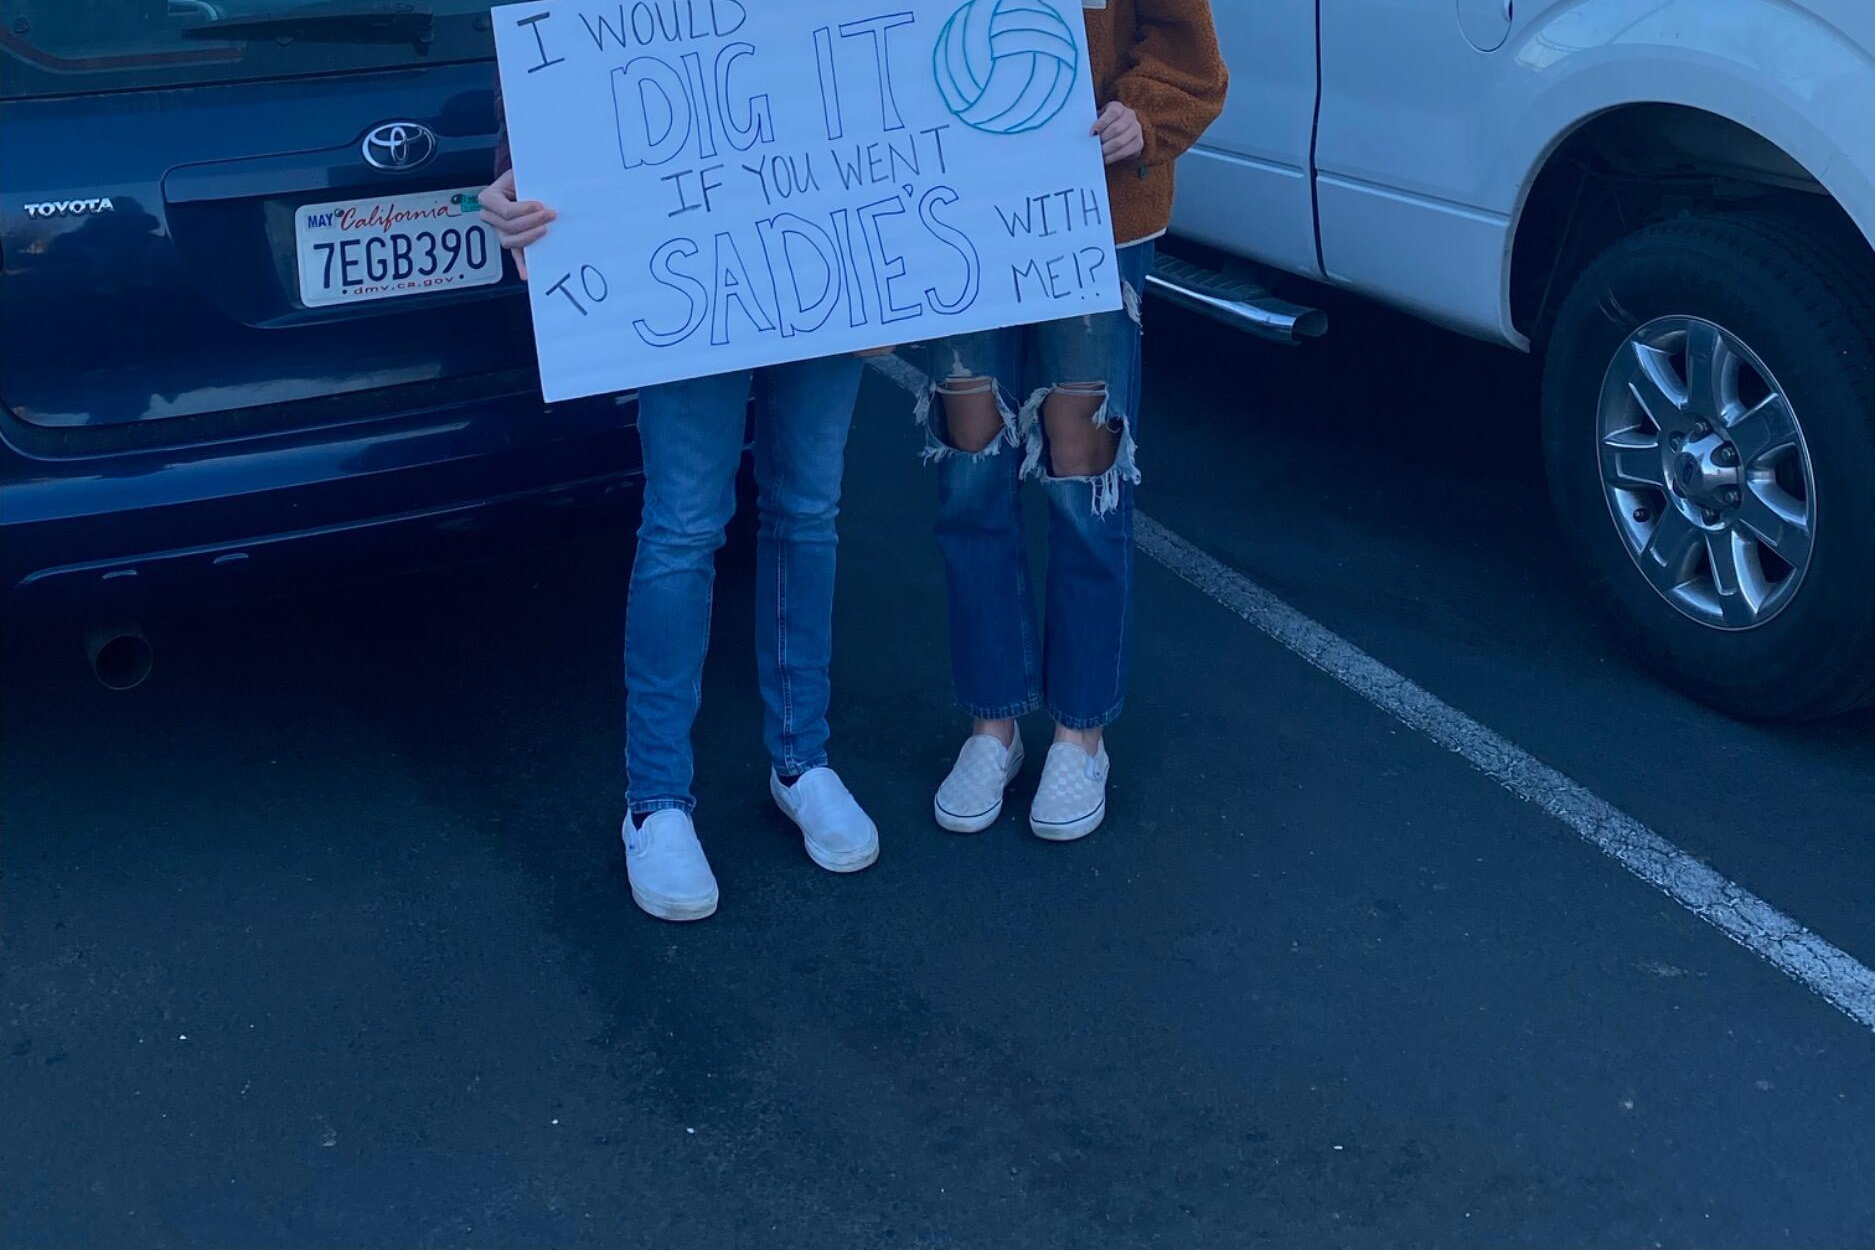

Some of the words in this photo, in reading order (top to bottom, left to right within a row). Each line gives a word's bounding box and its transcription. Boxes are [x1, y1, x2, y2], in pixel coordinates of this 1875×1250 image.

[517, 12, 565, 73] I
[610, 41, 775, 170] DIG
[813, 11, 915, 140] IT
[660, 164, 725, 218] IF
[742, 152, 820, 205] YOU
[831, 125, 950, 190] WENT
[24, 197, 115, 217] TOYOTA
[308, 212, 333, 229] MAY
[340, 203, 462, 233] California
[313, 225, 487, 289] 7EGB390
[353, 276, 455, 295] dmv.ca.gov
[545, 264, 608, 317] TO
[632, 184, 980, 348] SADIE'S
[994, 188, 1102, 238] WITH
[1011, 246, 1105, 303] ME!?
